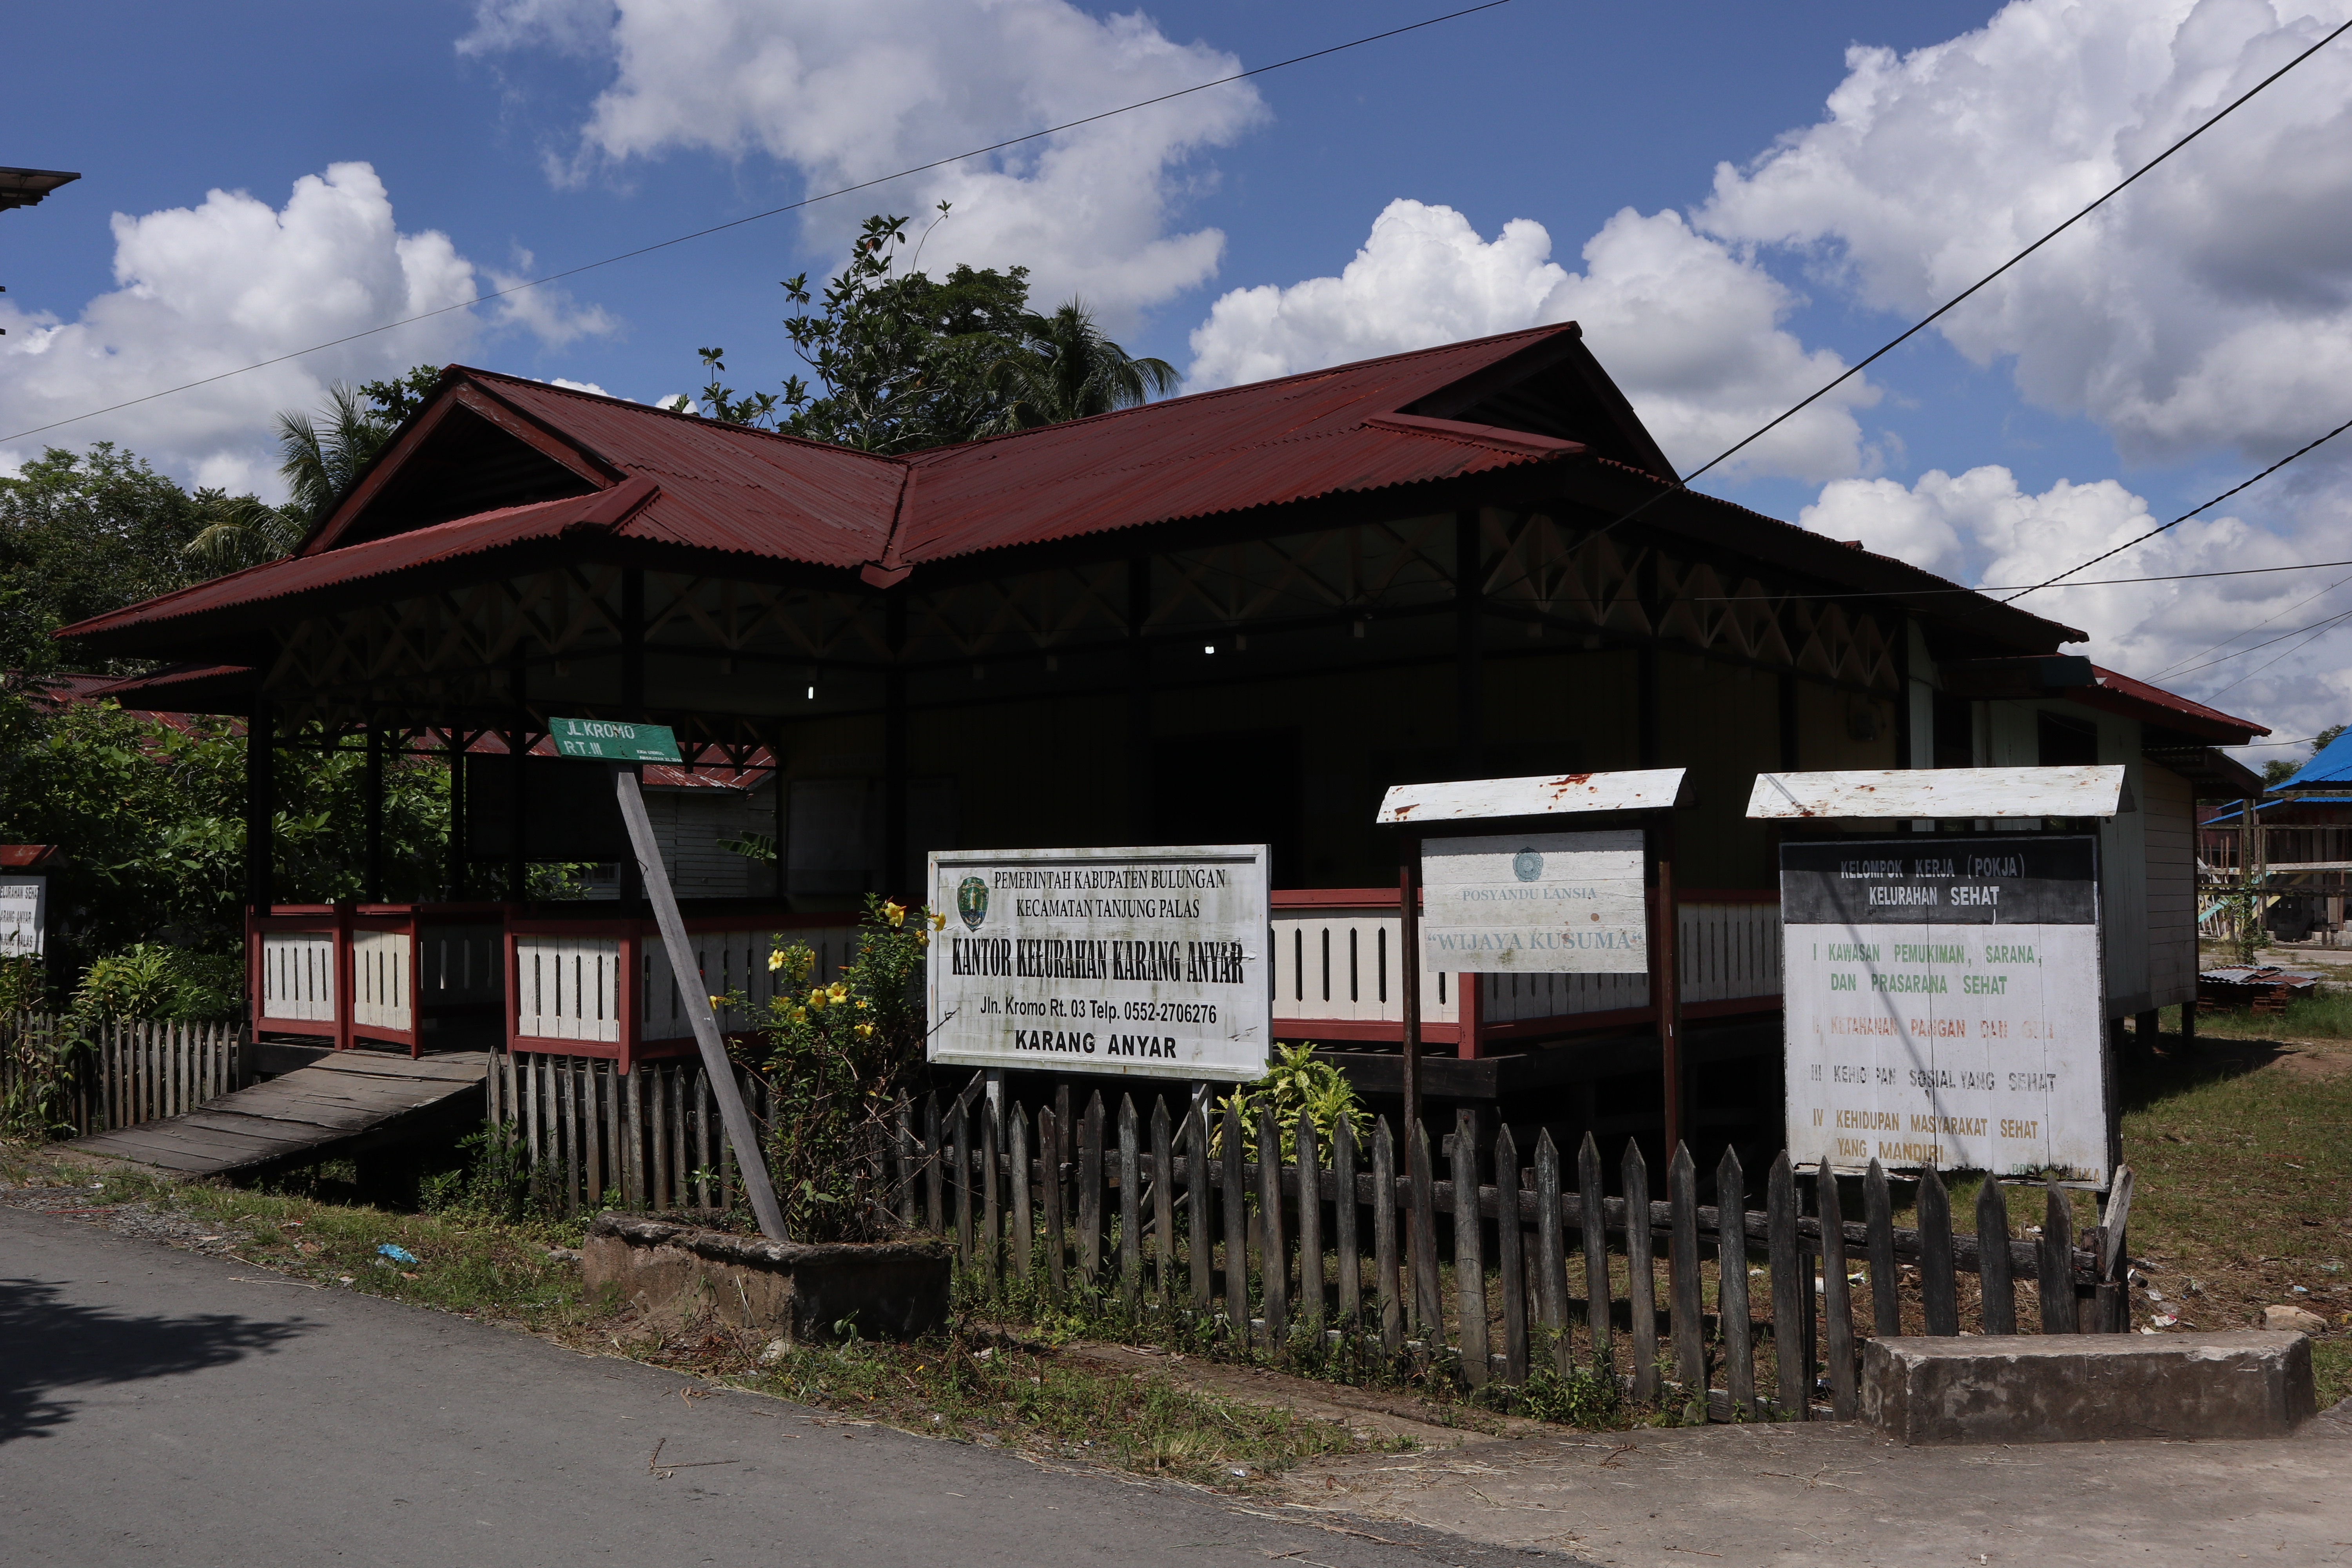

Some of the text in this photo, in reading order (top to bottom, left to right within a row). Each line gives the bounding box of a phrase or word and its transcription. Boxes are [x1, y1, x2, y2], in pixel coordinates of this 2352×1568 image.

[822, 756, 883, 768] PENGUMUM
[1841, 860, 1903, 878] KELOMPOK
[1915, 859, 1955, 878] KERJA
[994, 869, 1226, 889] PEMERINTAH KABUPATEN BULUNGAN
[0, 886, 40, 900] ELURAHAN SEHAT
[1463, 887, 1597, 901] POSYANDU LANSIA
[1869, 886, 2000, 906] KELURAHAN SEHAT
[0, 910, 31, 924] ARANG ANYAR
[1016, 899, 1200, 918] KECAMATAN TANJUNG PALAS
[953, 938, 1244, 984] KANTOR KELURAHAN KARANG ANYAR
[1828, 943, 1880, 962] KAWASAN
[1831, 973, 2007, 995] DAN PRASARANA SEHAT
[980, 996, 1217, 1024] Jln. Kromo Rt. 03 Telp. 0552-2706276
[1831, 1016, 1898, 1037] KETAHANAN
[1911, 1018, 1966, 1038] PANGAN
[1016, 1030, 1176, 1059] KARANG ANYAR
[1811, 1064, 2056, 1092] III KEHIDPAN SOSIAL YANG SEHAT
[1813, 1108, 2038, 1139] IV KEHIDUPAN MASYARAKAT SEHAT
[1837, 1138, 1944, 1163] YANG MANDIRI
